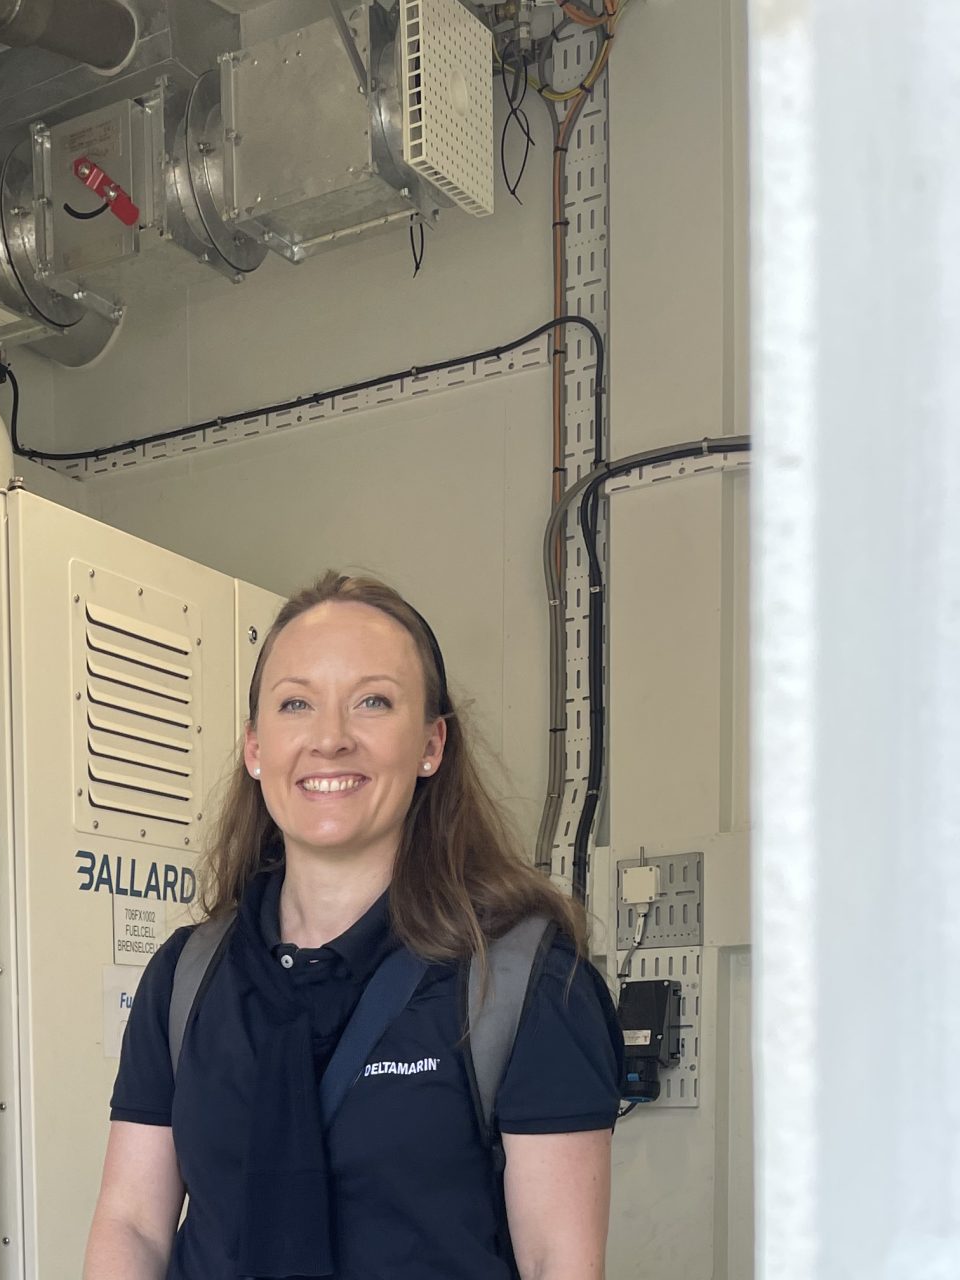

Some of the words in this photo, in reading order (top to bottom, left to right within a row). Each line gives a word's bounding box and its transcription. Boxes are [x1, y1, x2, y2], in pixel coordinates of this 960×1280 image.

[74, 849, 197, 904] BALLARD
[125, 924, 157, 939] FUELCELL
[117, 939, 164, 955] BRENSELCELL
[120, 992, 135, 1009] Fu
